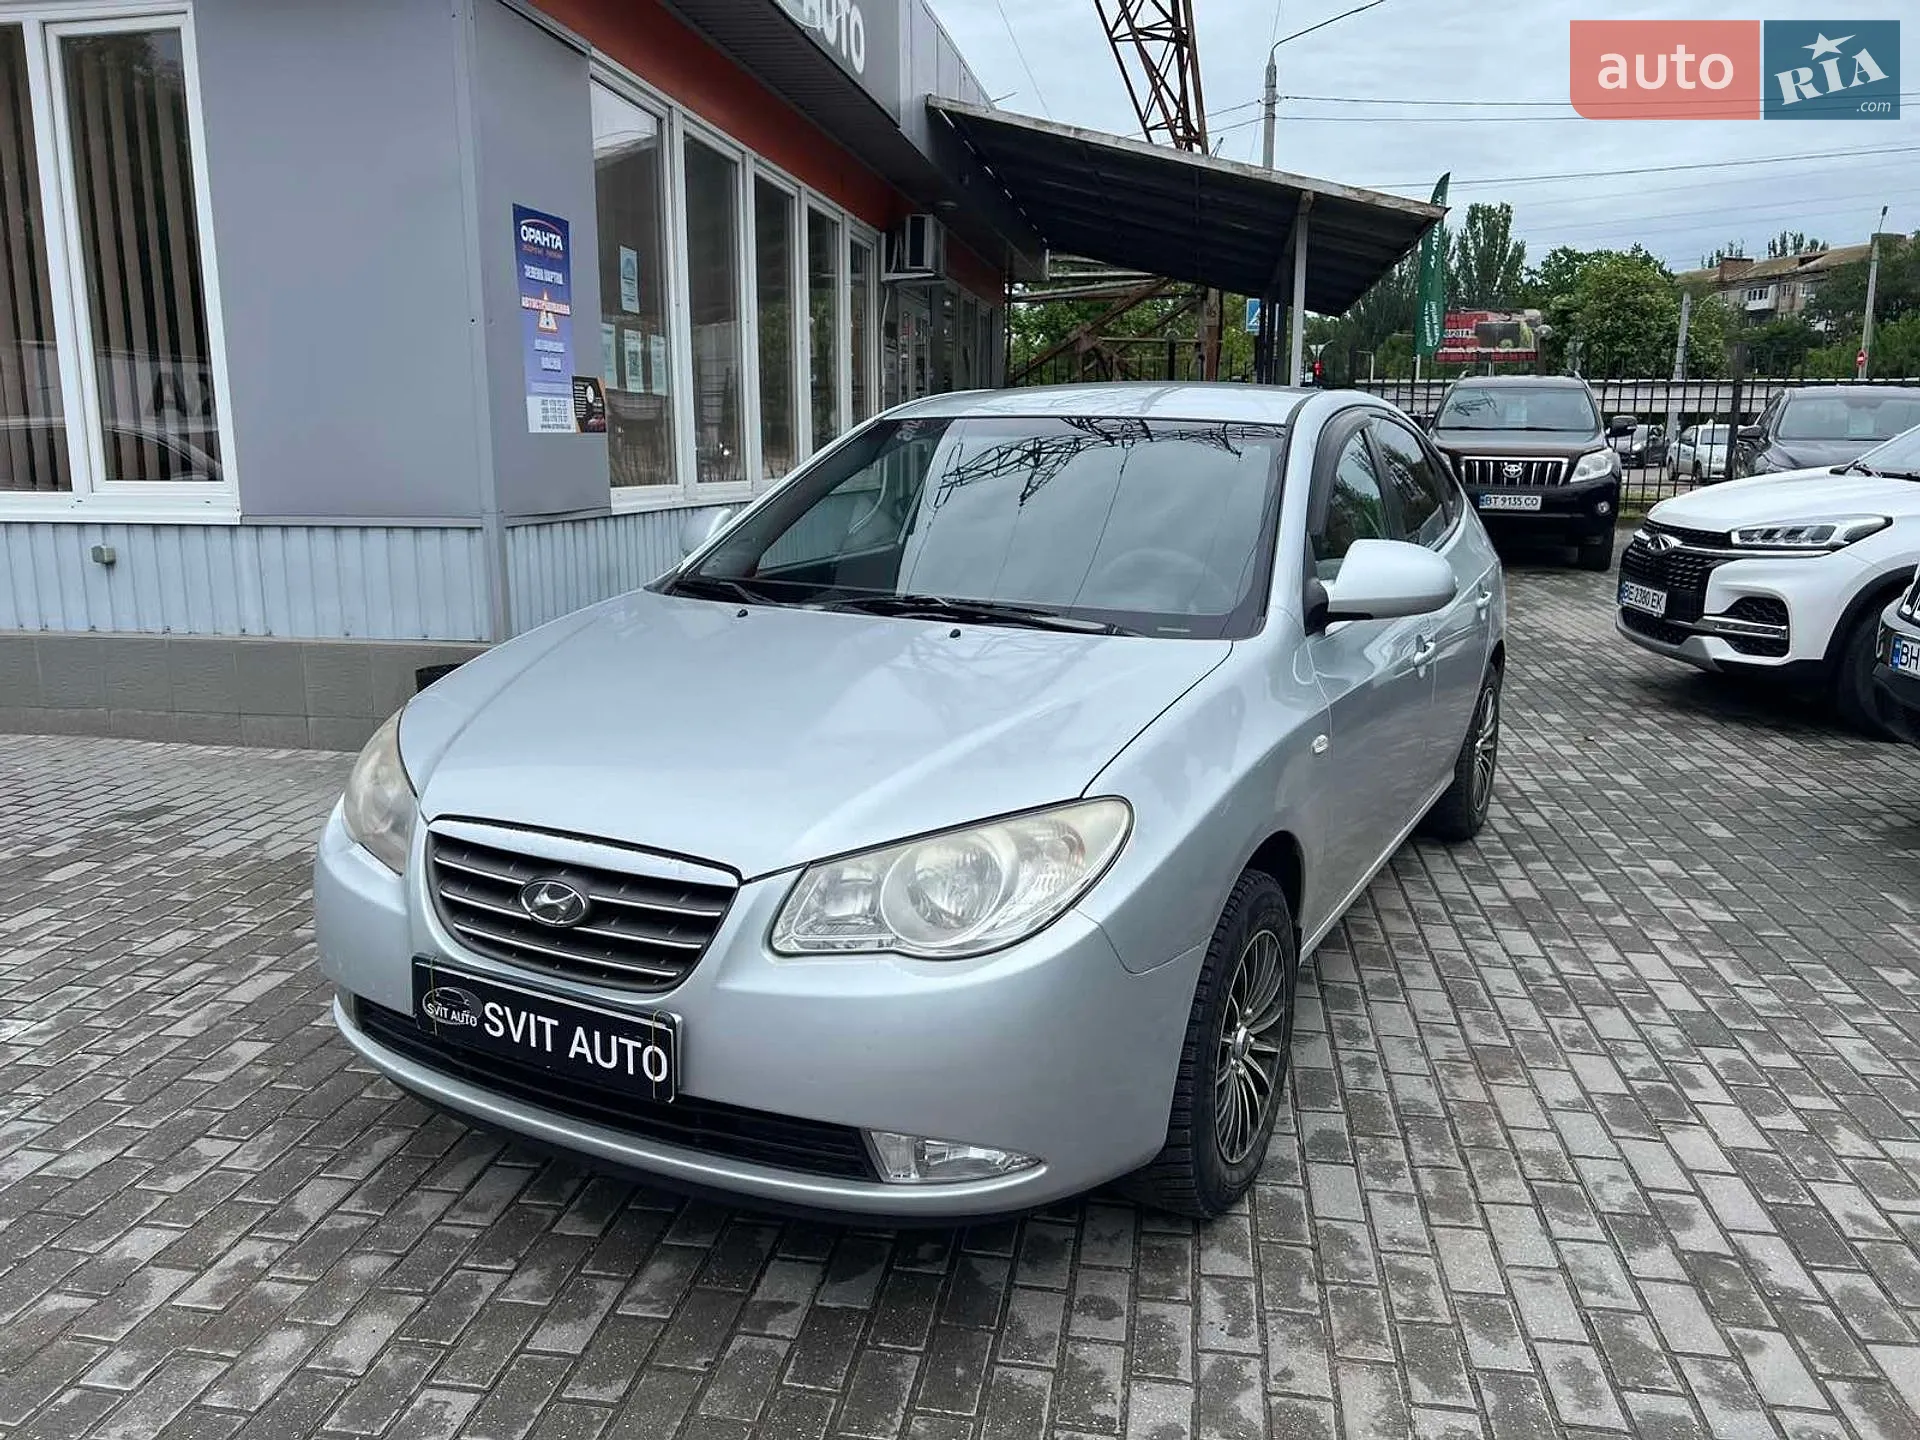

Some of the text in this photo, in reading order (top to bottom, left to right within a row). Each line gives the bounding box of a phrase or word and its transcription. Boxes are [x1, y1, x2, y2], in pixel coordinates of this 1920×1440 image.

[520, 225, 563, 251] ОРАНТА
[1485, 496, 1499, 506] BT
[1524, 497, 1539, 507] CO
[1651, 592, 1663, 611] EK
[1899, 643, 1920, 671] BH
[427, 1002, 478, 1027] SVIT AUTO
[483, 1001, 668, 1083] SVIT AUTO
